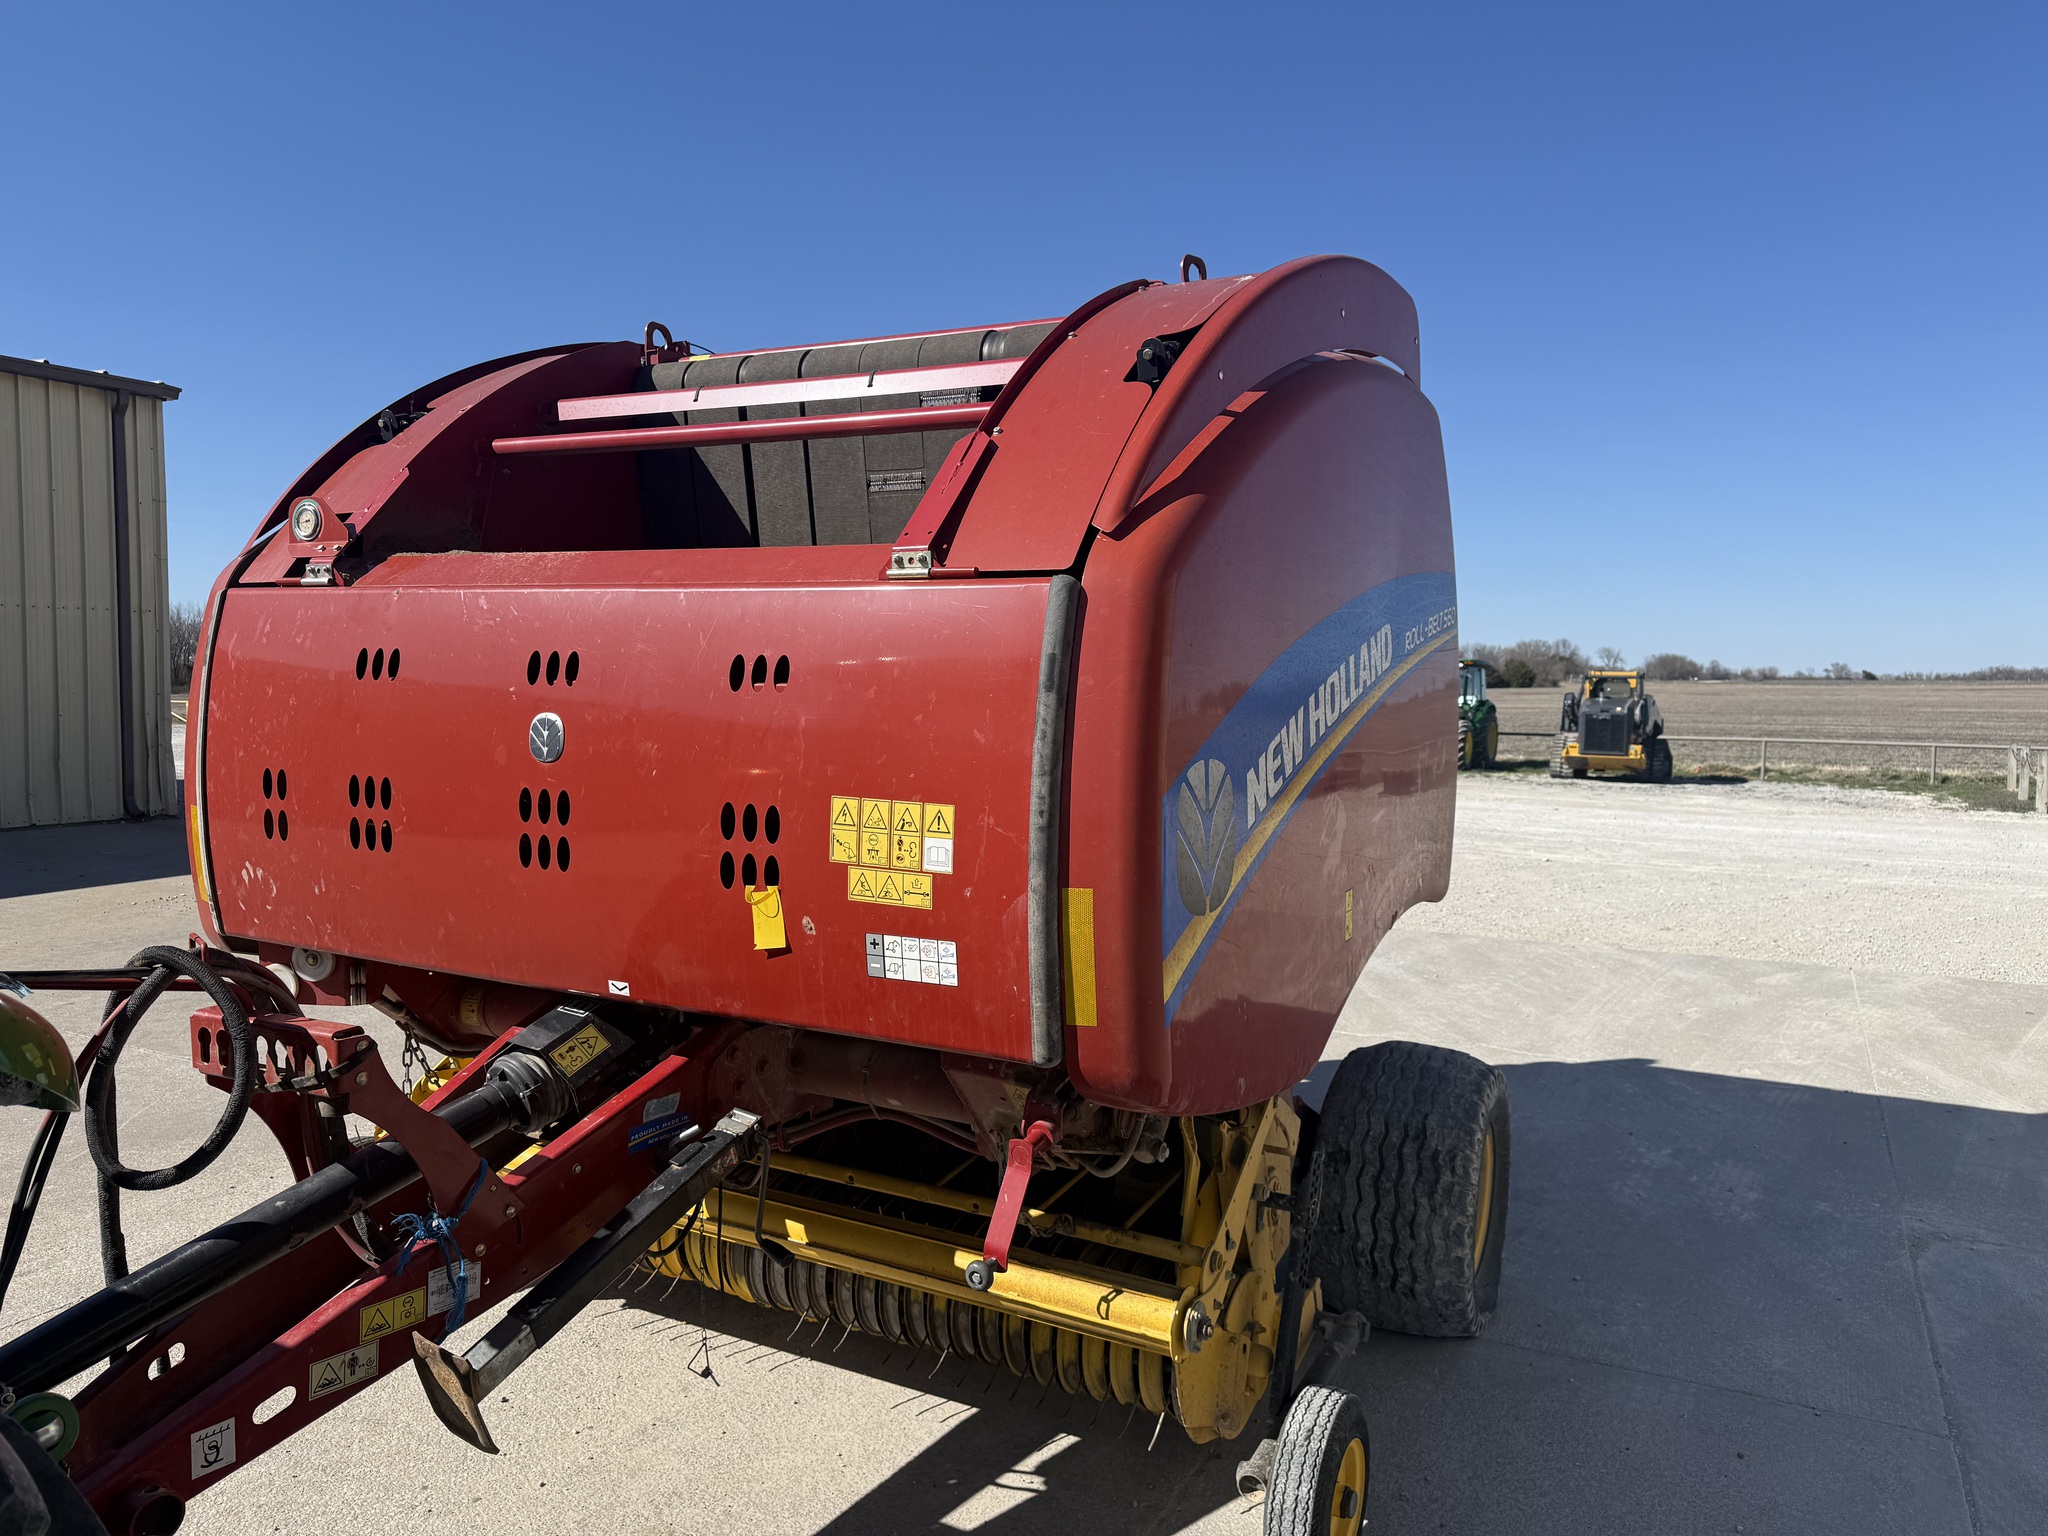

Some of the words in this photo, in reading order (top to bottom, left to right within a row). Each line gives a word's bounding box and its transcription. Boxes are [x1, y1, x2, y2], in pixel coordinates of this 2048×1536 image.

[1246, 705, 1304, 830] NEW
[1308, 623, 1393, 748] HOLLAND
[630, 1125, 660, 1142] PROUDLY
[661, 1117, 680, 1128] MADE
[647, 1136, 660, 1145] NEW
